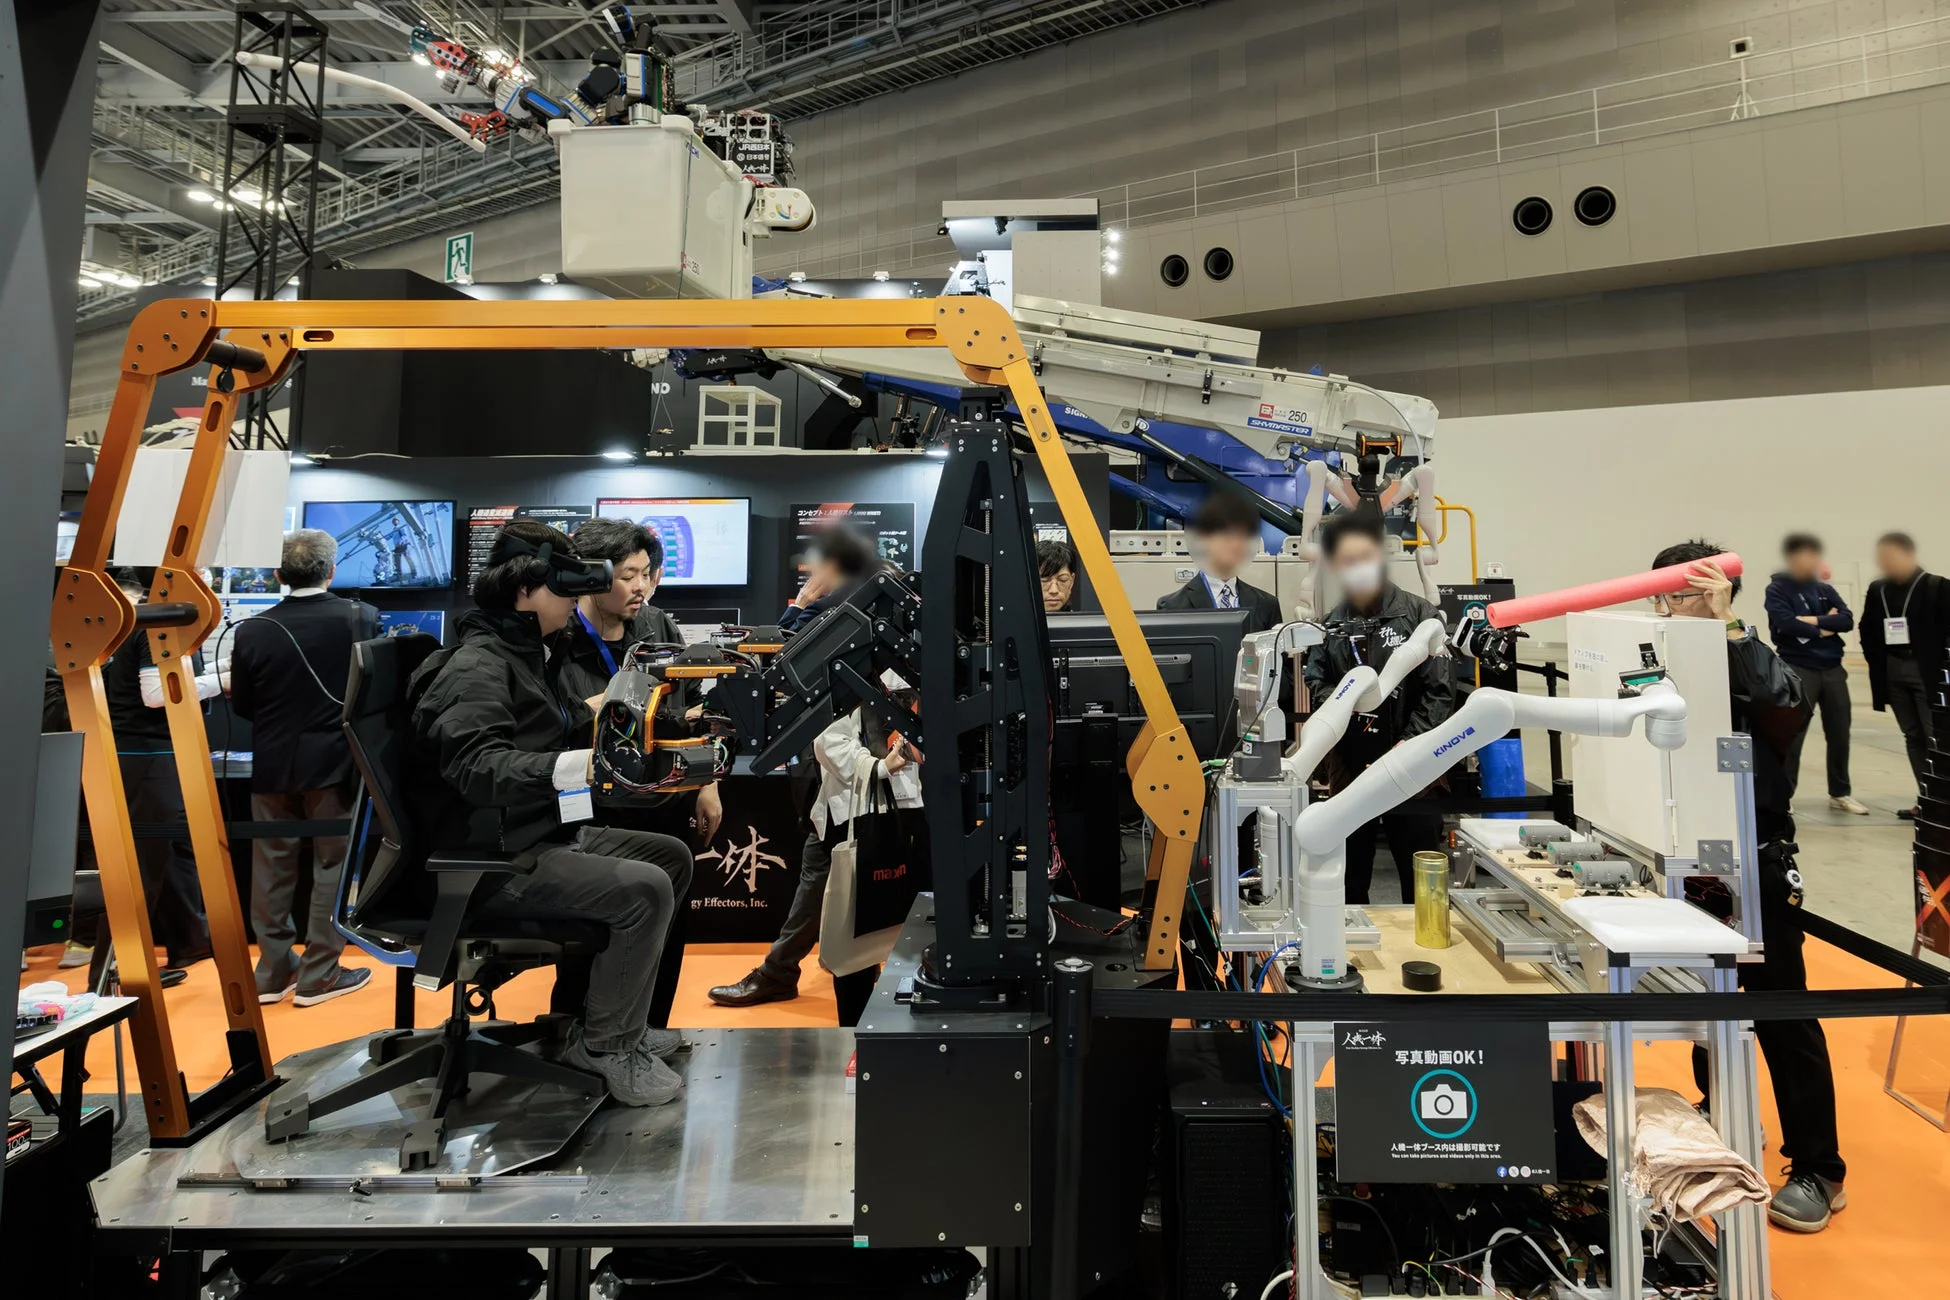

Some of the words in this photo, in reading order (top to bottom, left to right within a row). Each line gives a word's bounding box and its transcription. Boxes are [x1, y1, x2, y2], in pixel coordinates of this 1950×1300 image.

[1288, 410, 1307, 422] 250
[1250, 420, 1310, 434] SKYMASTER
[1433, 726, 1476, 758] KINOVA
[704, 897, 748, 908] Effectors,
[750, 898, 768, 908] Inc.
[1342, 1030, 1386, 1046] 人機一体
[1396, 1050, 1484, 1064] 写真動画OK！
[1391, 1143, 1500, 1152] 人機一体ブース内は撮影可能です
